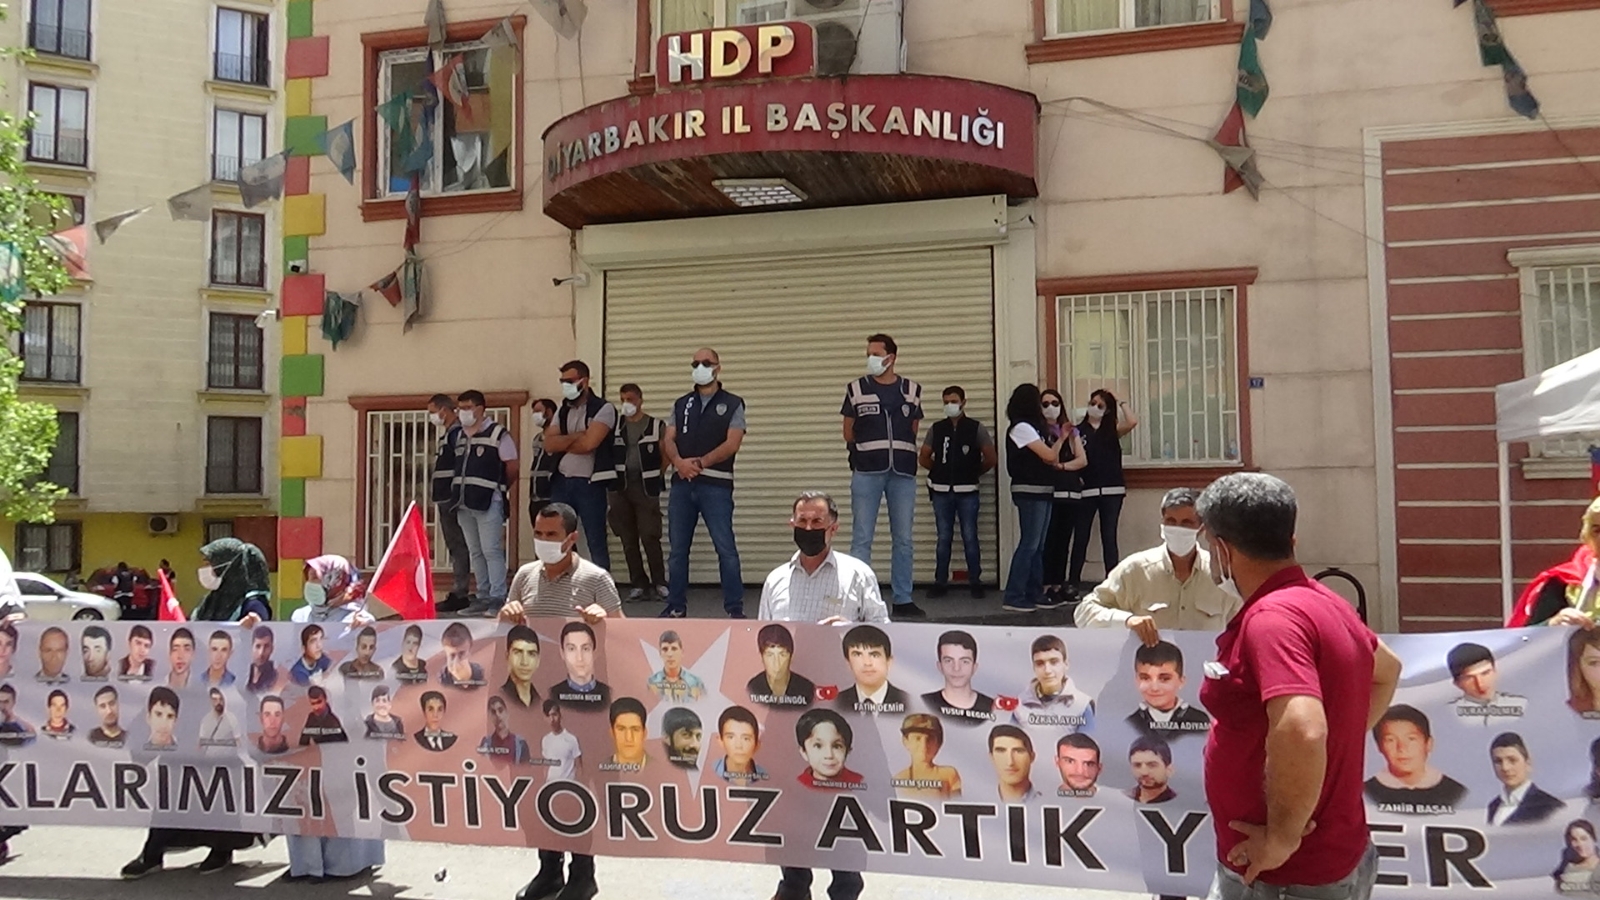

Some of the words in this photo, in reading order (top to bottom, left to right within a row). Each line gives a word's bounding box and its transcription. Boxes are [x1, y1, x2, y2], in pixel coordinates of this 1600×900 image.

[668, 25, 795, 84] HDP
[767, 102, 1005, 149] BAŞKANLIĞI
[750, 694, 777, 703] TUNCAY
[853, 702, 877, 711] FATİH
[878, 702, 904, 712] DEMİR
[940, 706, 965, 716] YUSUF
[1028, 712, 1058, 725] ÖZKAN
[1060, 714, 1087, 726] AYDIN
[1149, 721, 1179, 730] HAMZA
[1180, 721, 1211, 730] ADIYAM
[1378, 802, 1414, 813] ZAHİR
[354, 756, 784, 846] İSTİYORUZ
[815, 795, 1108, 872] ARTIK
